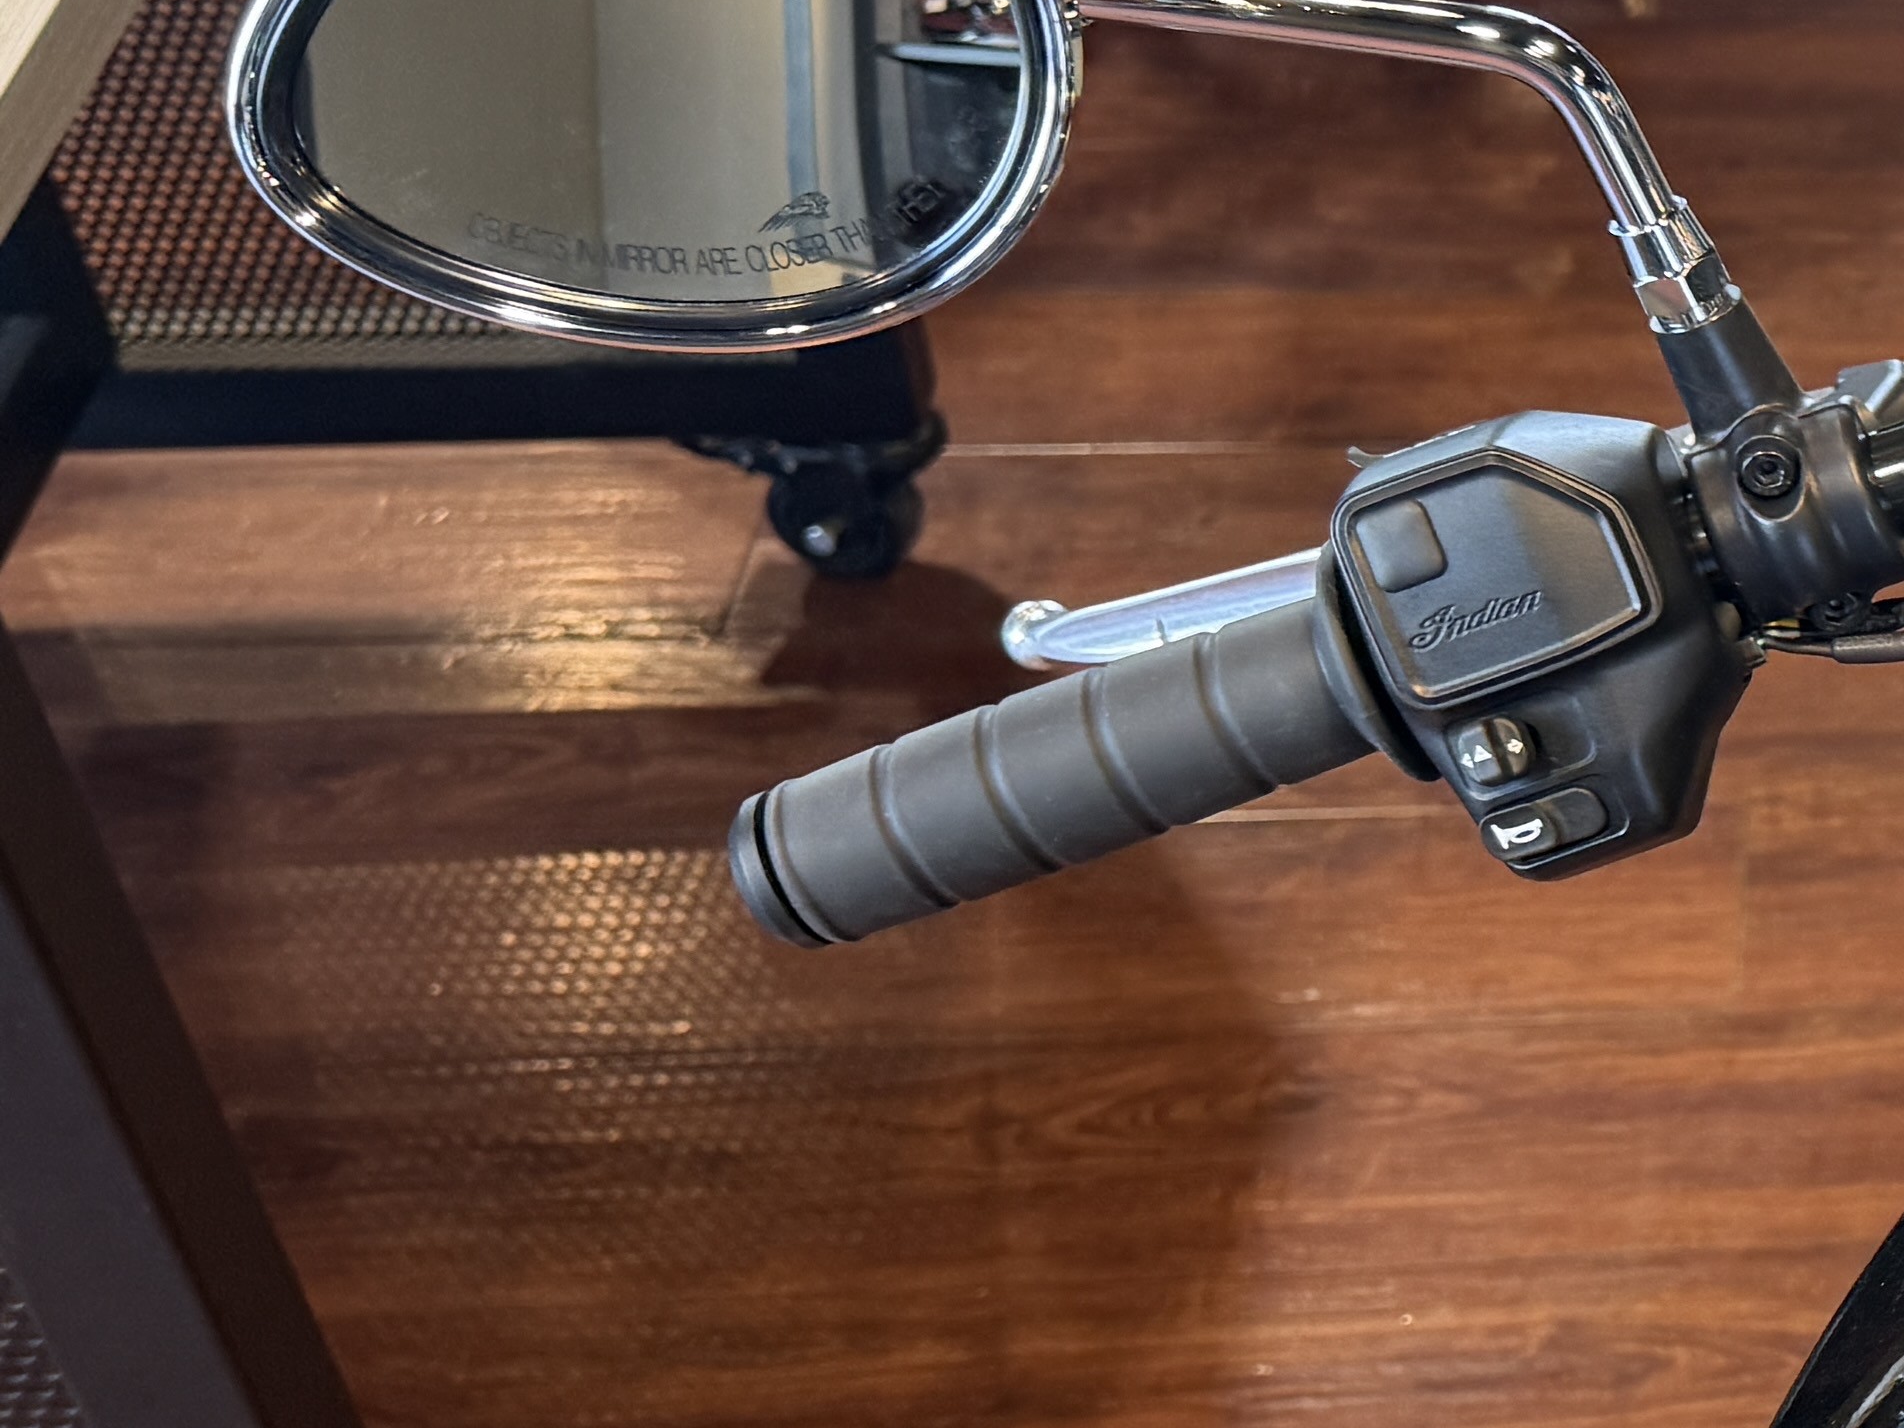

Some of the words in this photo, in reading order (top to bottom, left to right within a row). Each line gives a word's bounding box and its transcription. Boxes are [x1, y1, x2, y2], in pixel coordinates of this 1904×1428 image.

[601, 243, 689, 275] MIRROR
[696, 246, 742, 275] ARE
[745, 232, 832, 272] CLOSER
[1408, 590, 1541, 652] Indian
